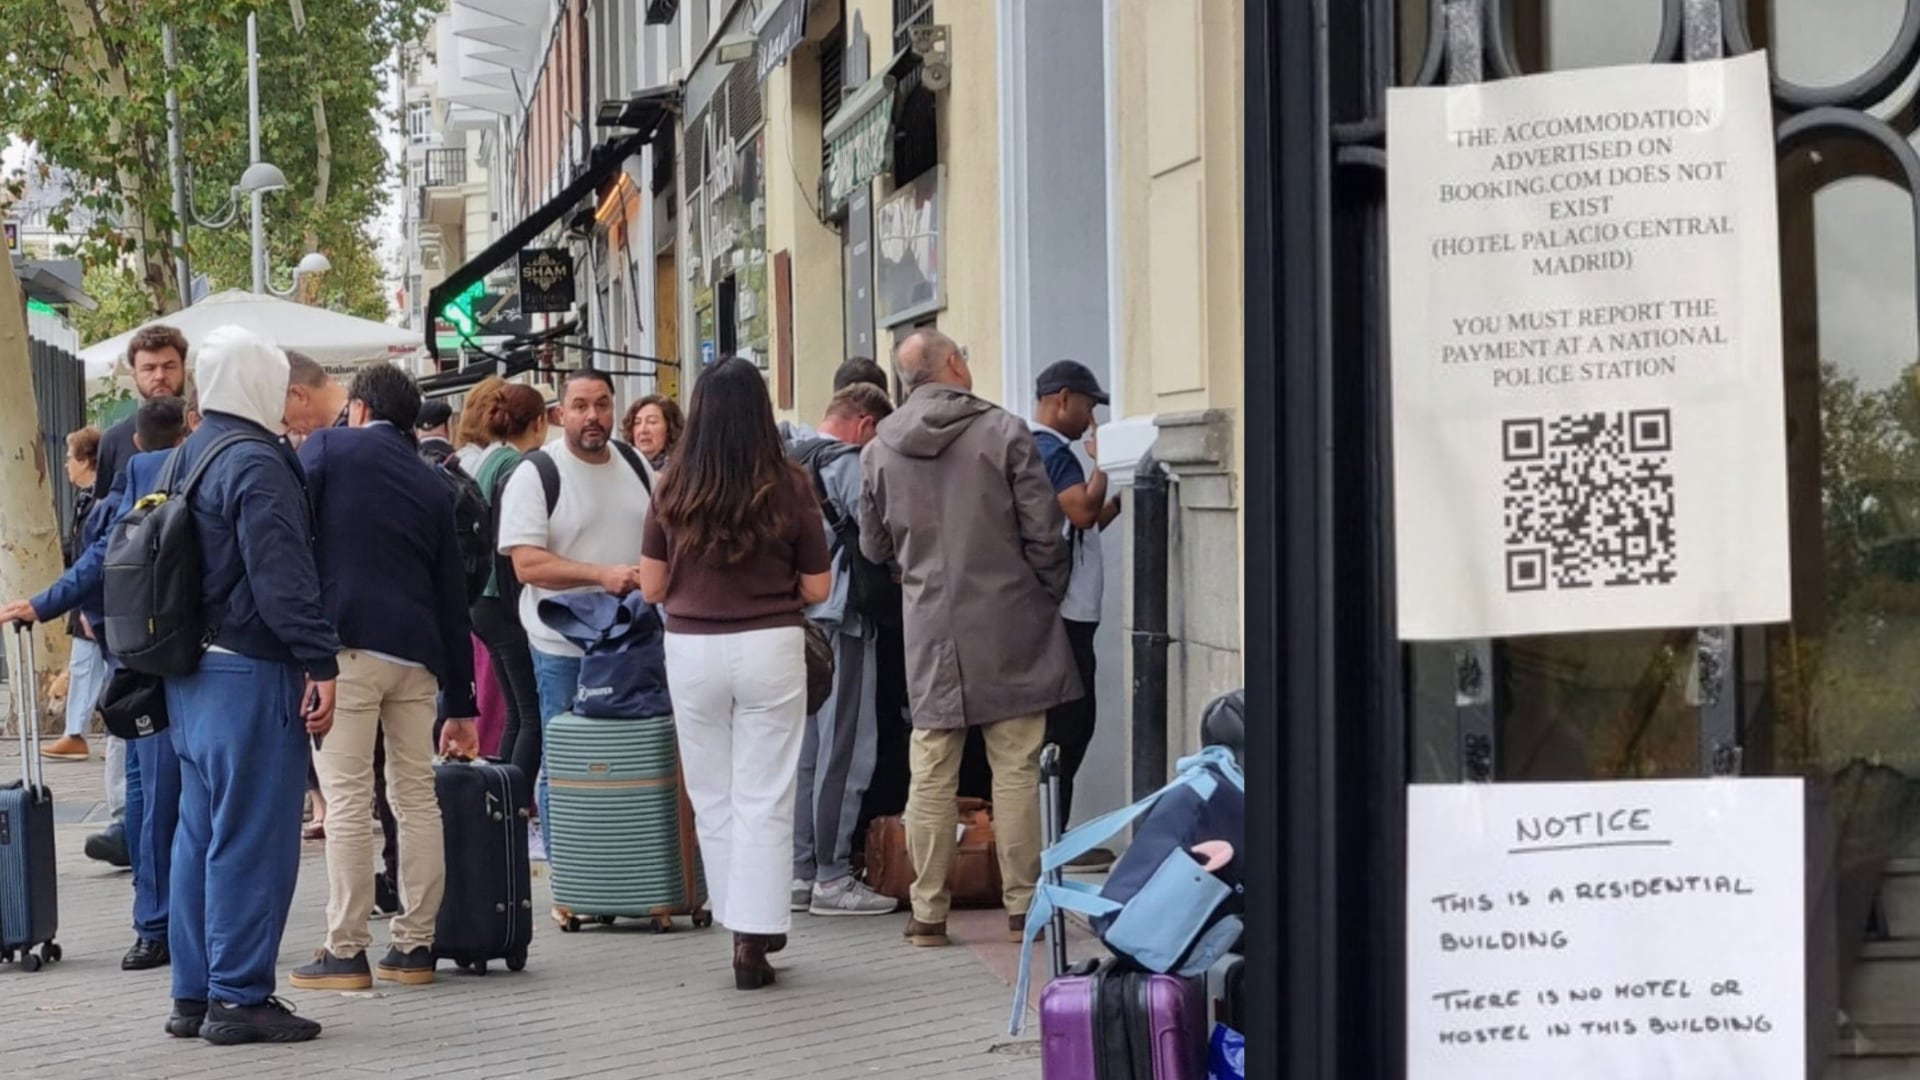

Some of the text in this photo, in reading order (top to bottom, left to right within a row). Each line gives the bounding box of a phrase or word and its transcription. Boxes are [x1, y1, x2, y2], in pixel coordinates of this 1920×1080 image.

[1456, 109, 1711, 148] THE ACCOMMODATION
[1491, 136, 1674, 172] ADVERTISED ON
[1439, 161, 1727, 203] BOOKING.COM DOES NOT
[1549, 195, 1613, 219] EXIST
[1432, 216, 1734, 259] (HOTEL PALACIO CENTRAL
[522, 266, 567, 277] SHAM
[1532, 249, 1633, 276] MADRID)
[1453, 299, 1717, 335] YOU MUST REPORT THE
[1442, 325, 1727, 363] PAYMENT AT A NATIONAL
[1493, 355, 1676, 388] POLICE STATION
[1516, 809, 1651, 841] NOTICE
[1432, 877, 1752, 913] THIS IS A RESIDENTIAL
[1440, 931, 1568, 951] BUILDING
[1433, 980, 1742, 1010] THERE IS NO HOTEL OR
[1439, 1015, 1772, 1044] HOSTEL IN THIS BUILDING
